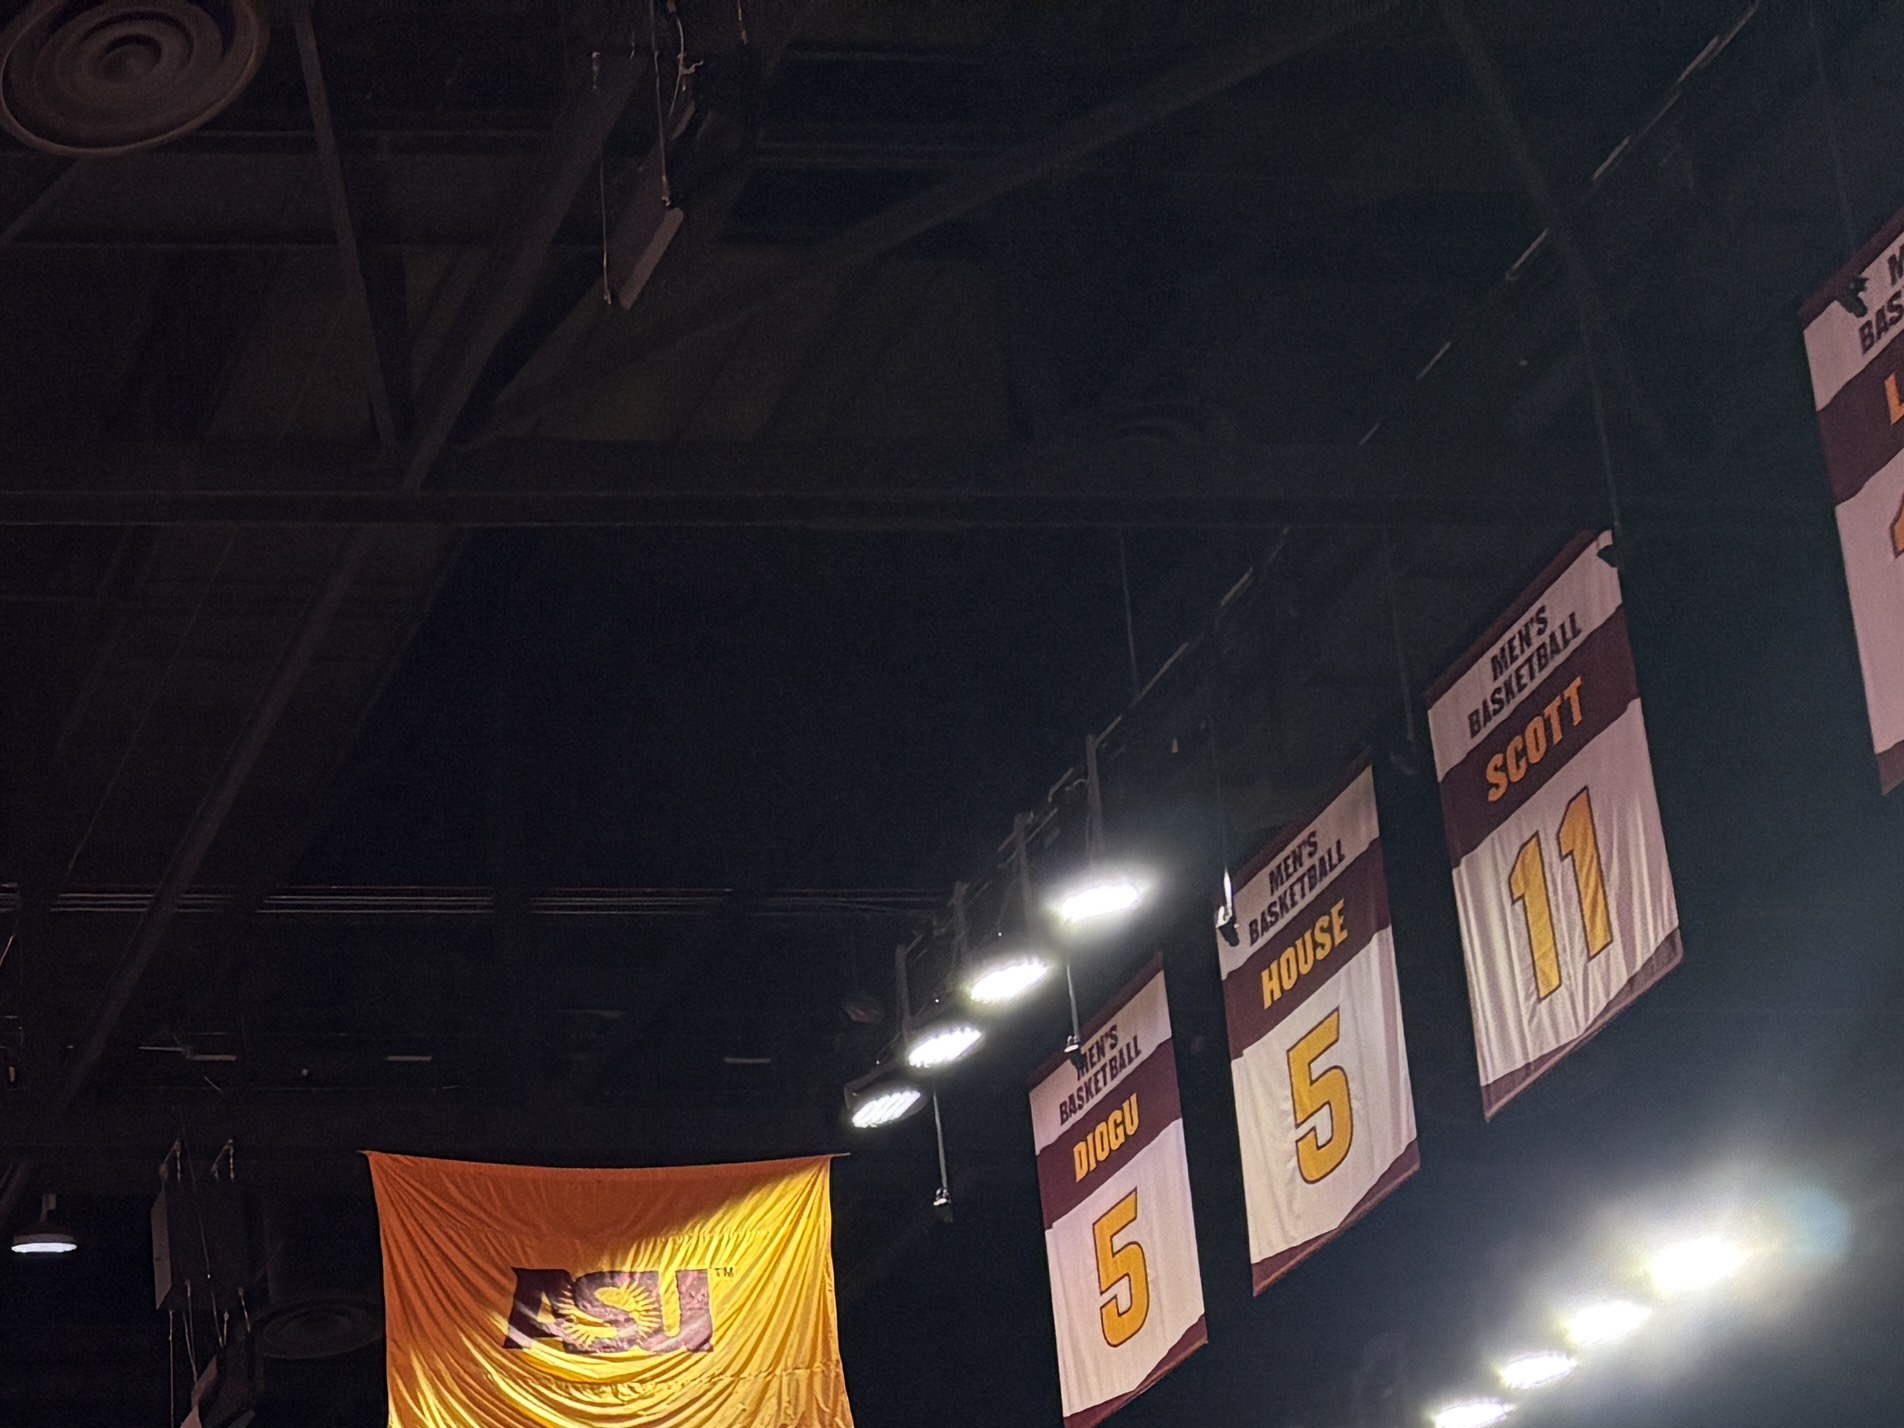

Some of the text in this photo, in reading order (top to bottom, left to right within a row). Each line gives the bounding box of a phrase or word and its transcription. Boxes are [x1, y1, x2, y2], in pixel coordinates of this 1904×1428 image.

[1468, 612, 1582, 740] BASKETBALL
[1491, 605, 1548, 680] MEN'S
[1485, 677, 1583, 802] SCOTT
[1249, 841, 1345, 946] BASKETBALL
[1269, 831, 1318, 896] MEN'S
[1508, 786, 1614, 1001] 11
[1261, 898, 1348, 1009] HOUSE
[1059, 1035, 1141, 1126] BASKETBALL
[1287, 1007, 1354, 1184] 5
[1073, 1093, 1140, 1183] DIOGU
[502, 1267, 714, 1353] ASU
[1092, 1187, 1150, 1348] 5
